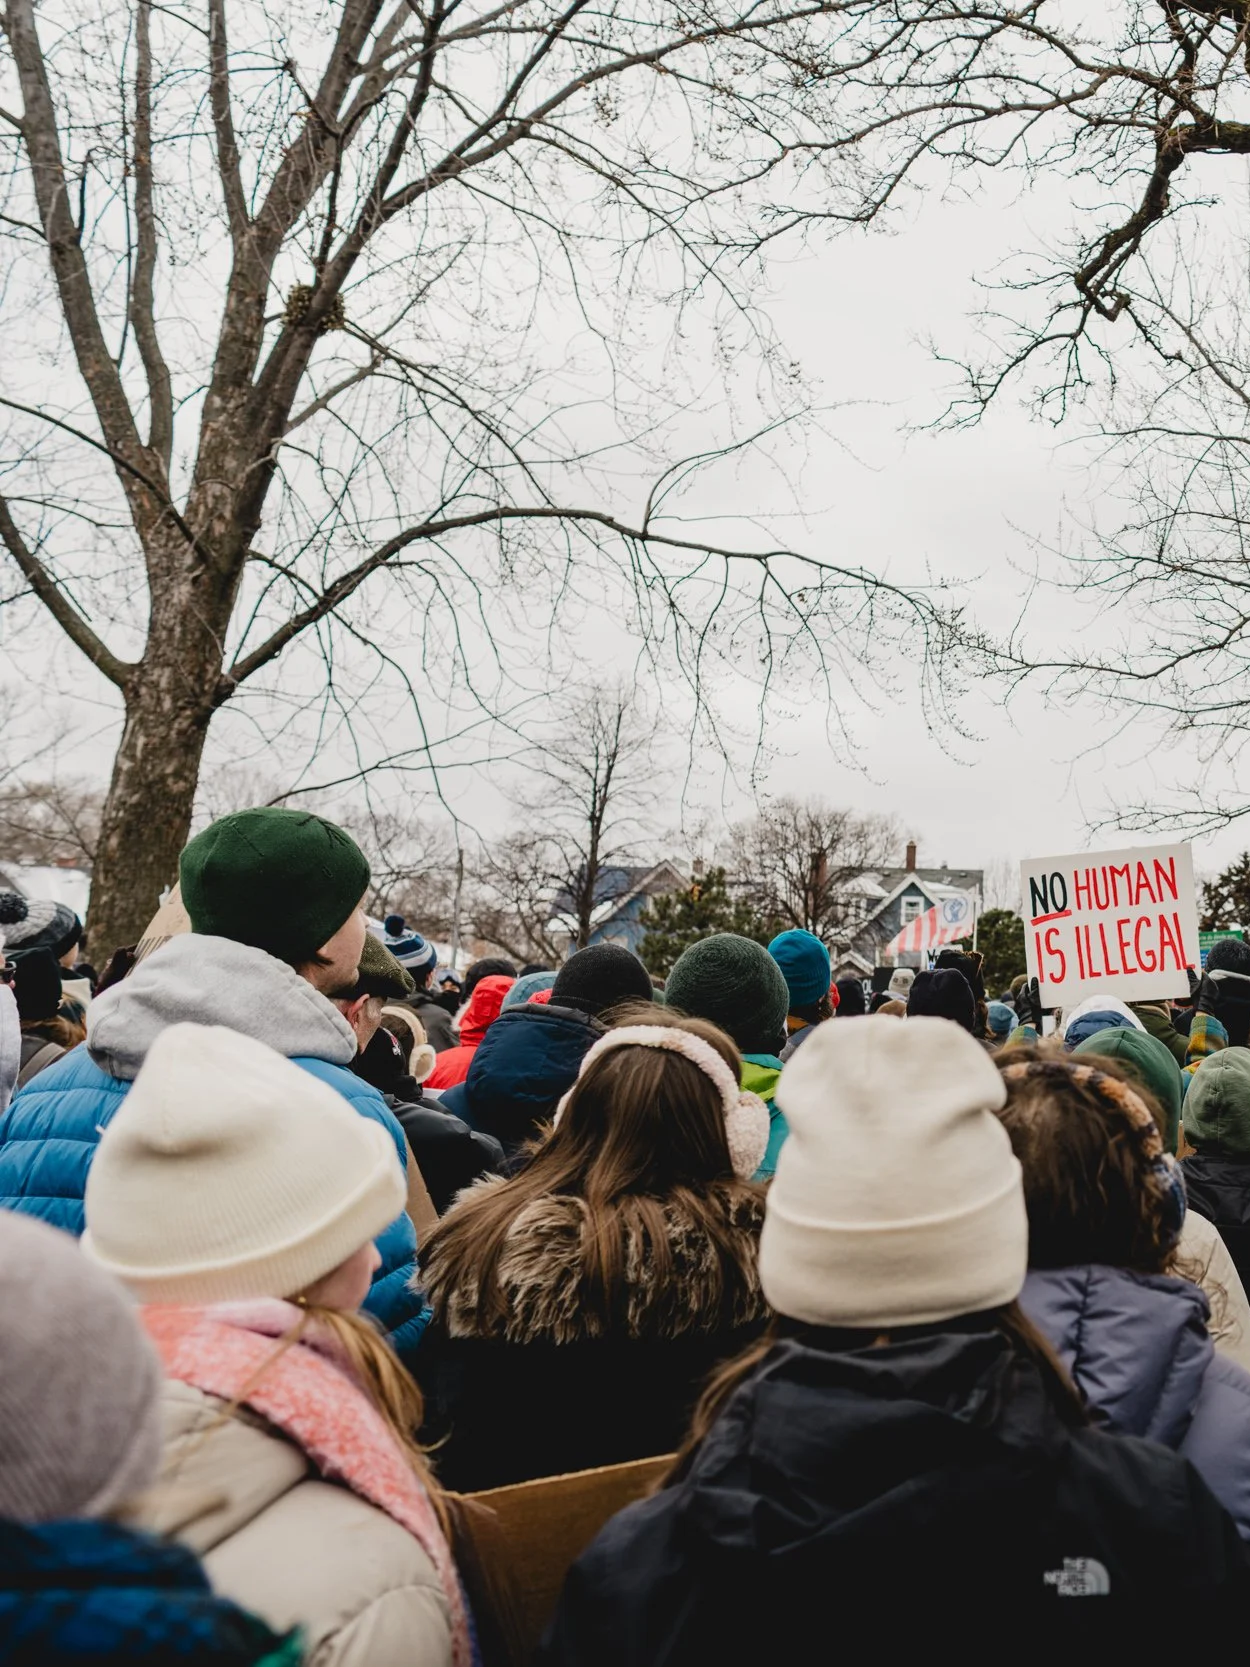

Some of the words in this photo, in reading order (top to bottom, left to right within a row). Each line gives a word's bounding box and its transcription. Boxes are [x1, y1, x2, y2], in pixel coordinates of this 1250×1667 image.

[1029, 871, 1068, 917] NO
[1073, 856, 1179, 911] HUMAN
[1035, 927, 1067, 984] IS
[1074, 912, 1196, 980] ILLEGAL
